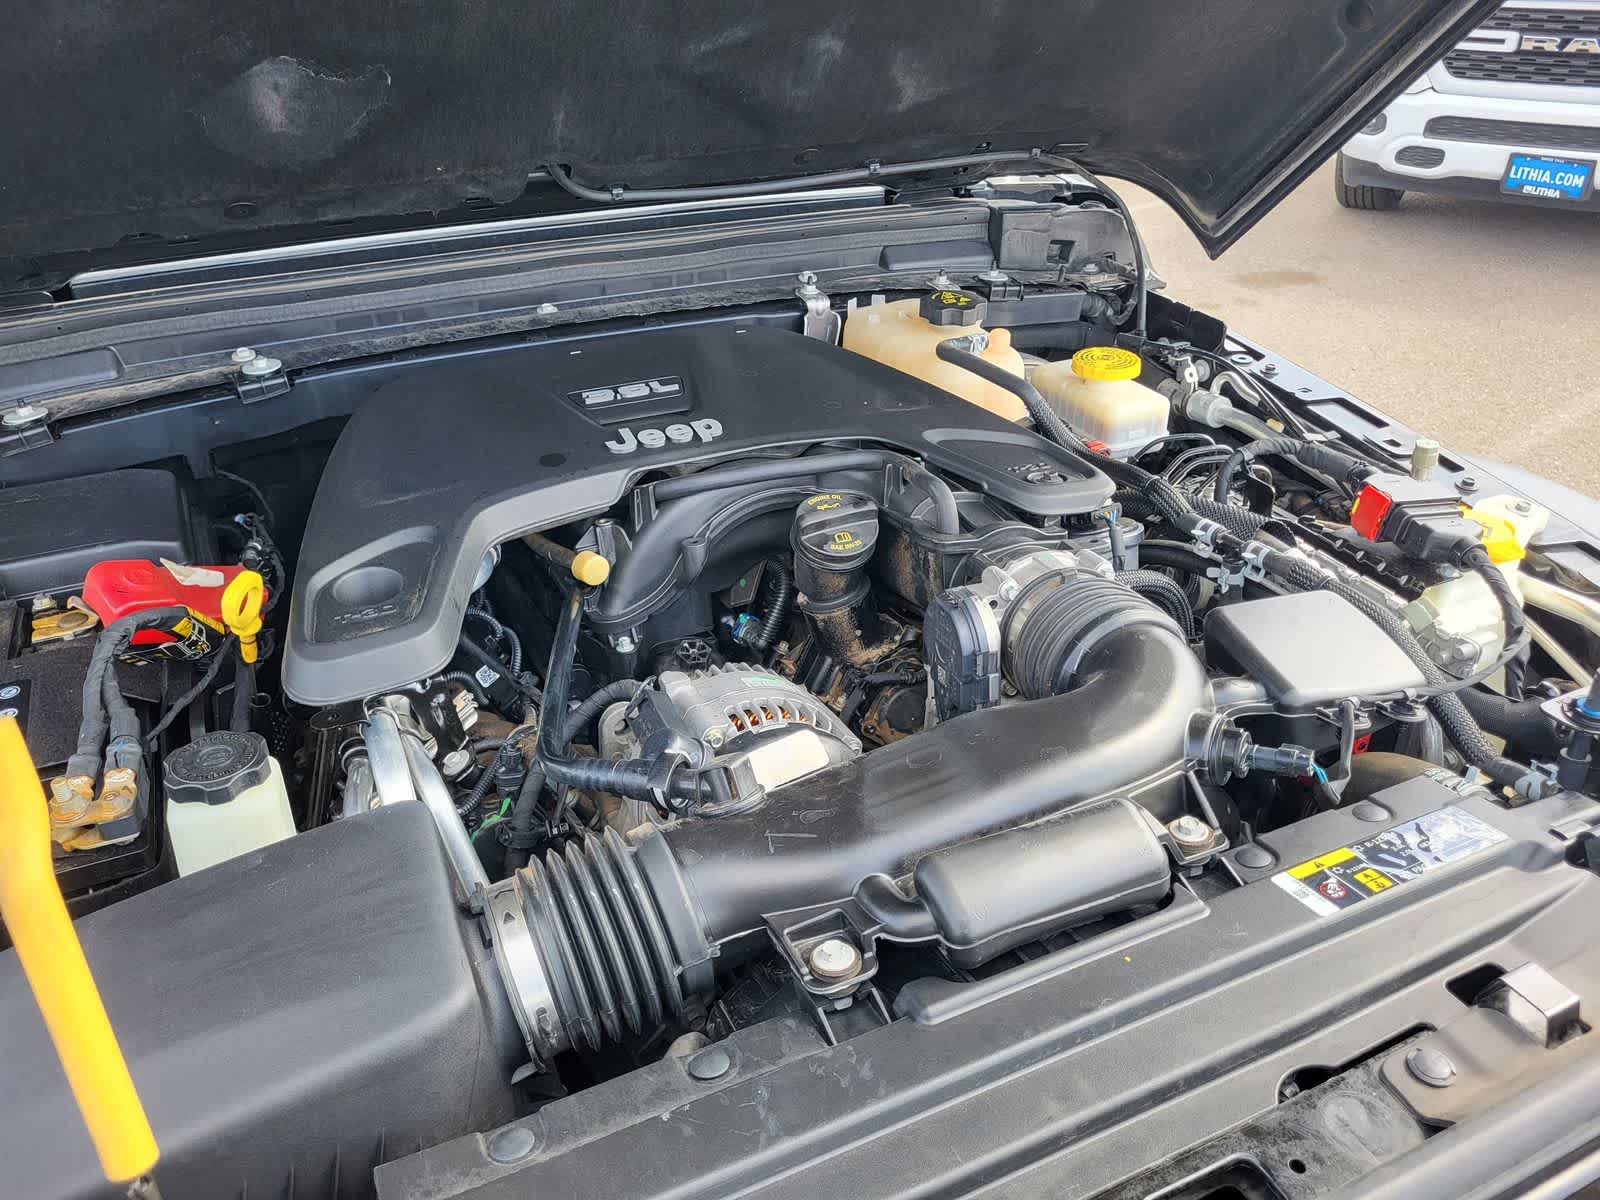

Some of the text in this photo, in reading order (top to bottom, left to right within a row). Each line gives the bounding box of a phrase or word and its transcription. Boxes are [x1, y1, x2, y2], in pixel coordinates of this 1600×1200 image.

[1509, 165, 1585, 188] LITHIA.COM
[1533, 187, 1560, 198] LITHIA
[604, 418, 724, 454] Jeep
